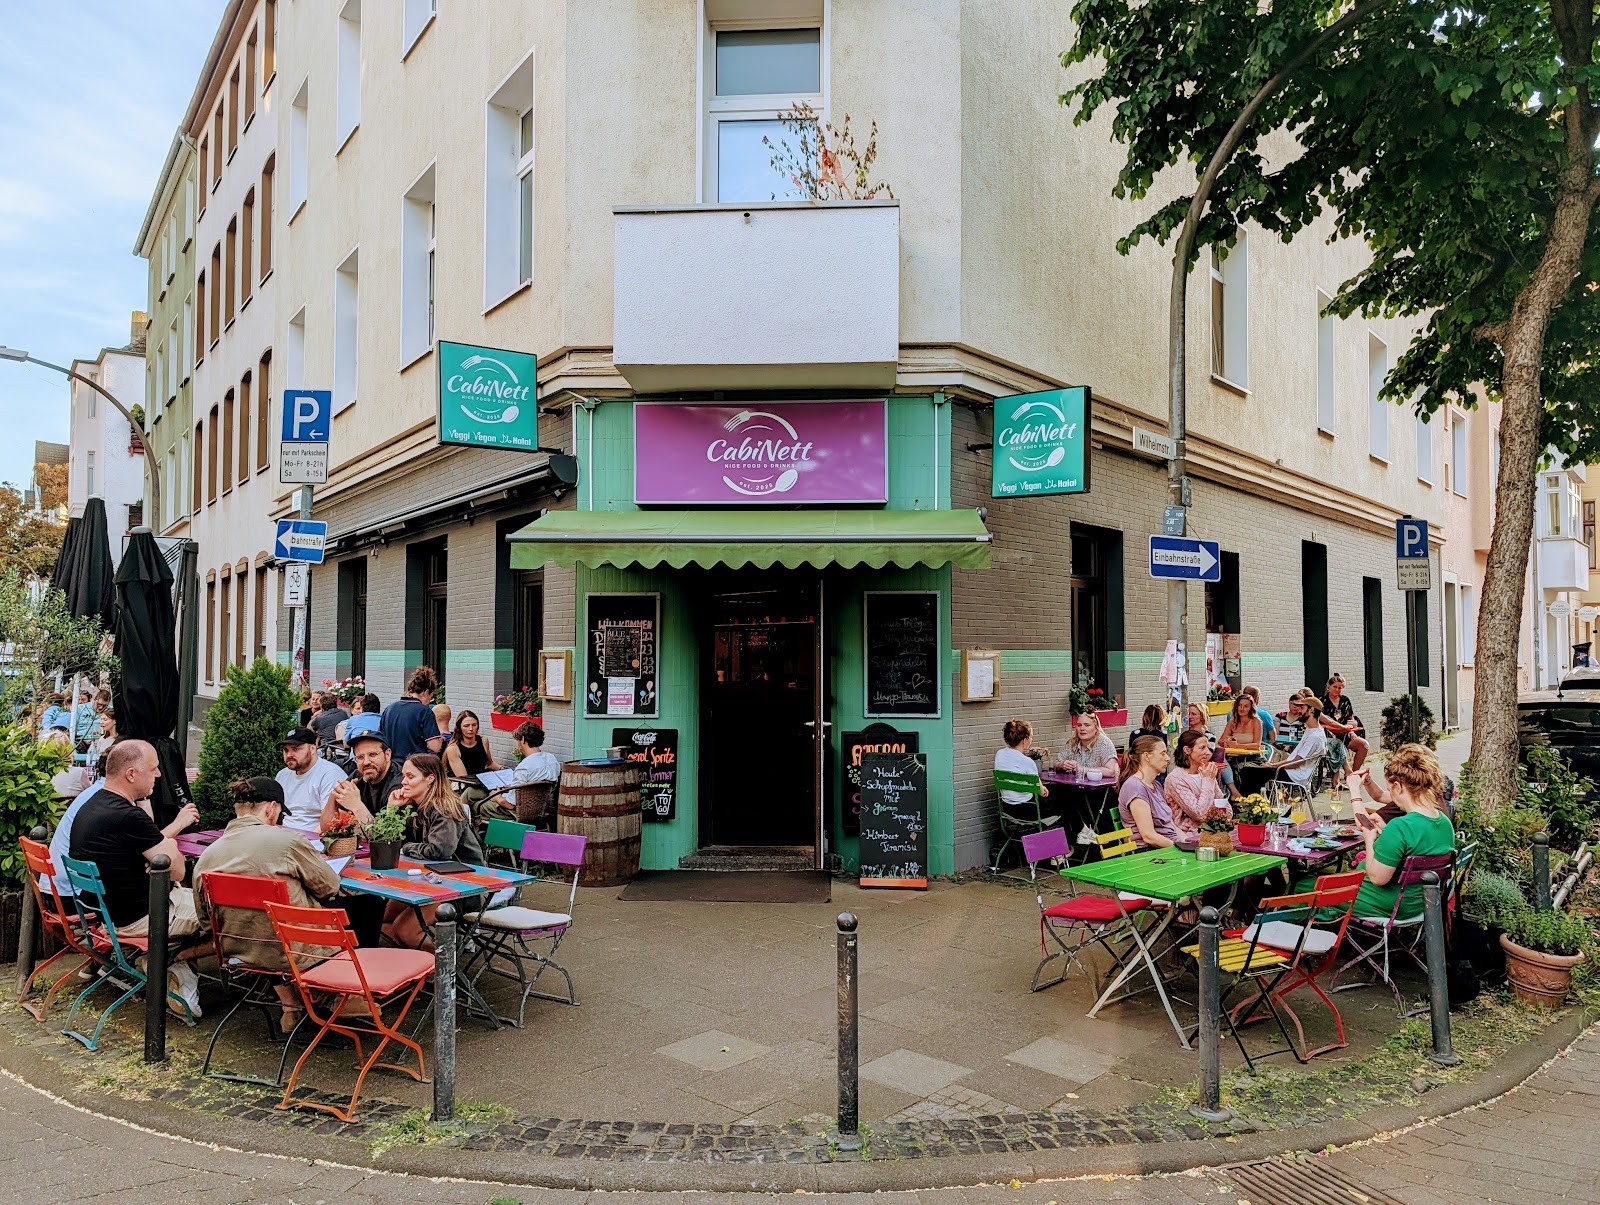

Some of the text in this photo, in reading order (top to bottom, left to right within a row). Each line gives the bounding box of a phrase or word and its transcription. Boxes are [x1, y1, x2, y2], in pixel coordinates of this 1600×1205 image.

[447, 375, 530, 401] CabiNett
[292, 396, 320, 439] P
[998, 423, 1077, 446] CabiNett
[512, 437, 532, 446] Halal
[1139, 433, 1171, 457] Wilhelmstr.
[292, 449, 300, 457] mit
[706, 437, 814, 462] CabiNett
[284, 460, 304, 468] Mo-Fr
[284, 469, 293, 477] Sa
[739, 481, 753, 490] est.
[1057, 478, 1077, 488] Halal
[1403, 524, 1421, 557] P
[1154, 551, 1201, 565] Einbahnstraße
[659, 797, 668, 805] TO
